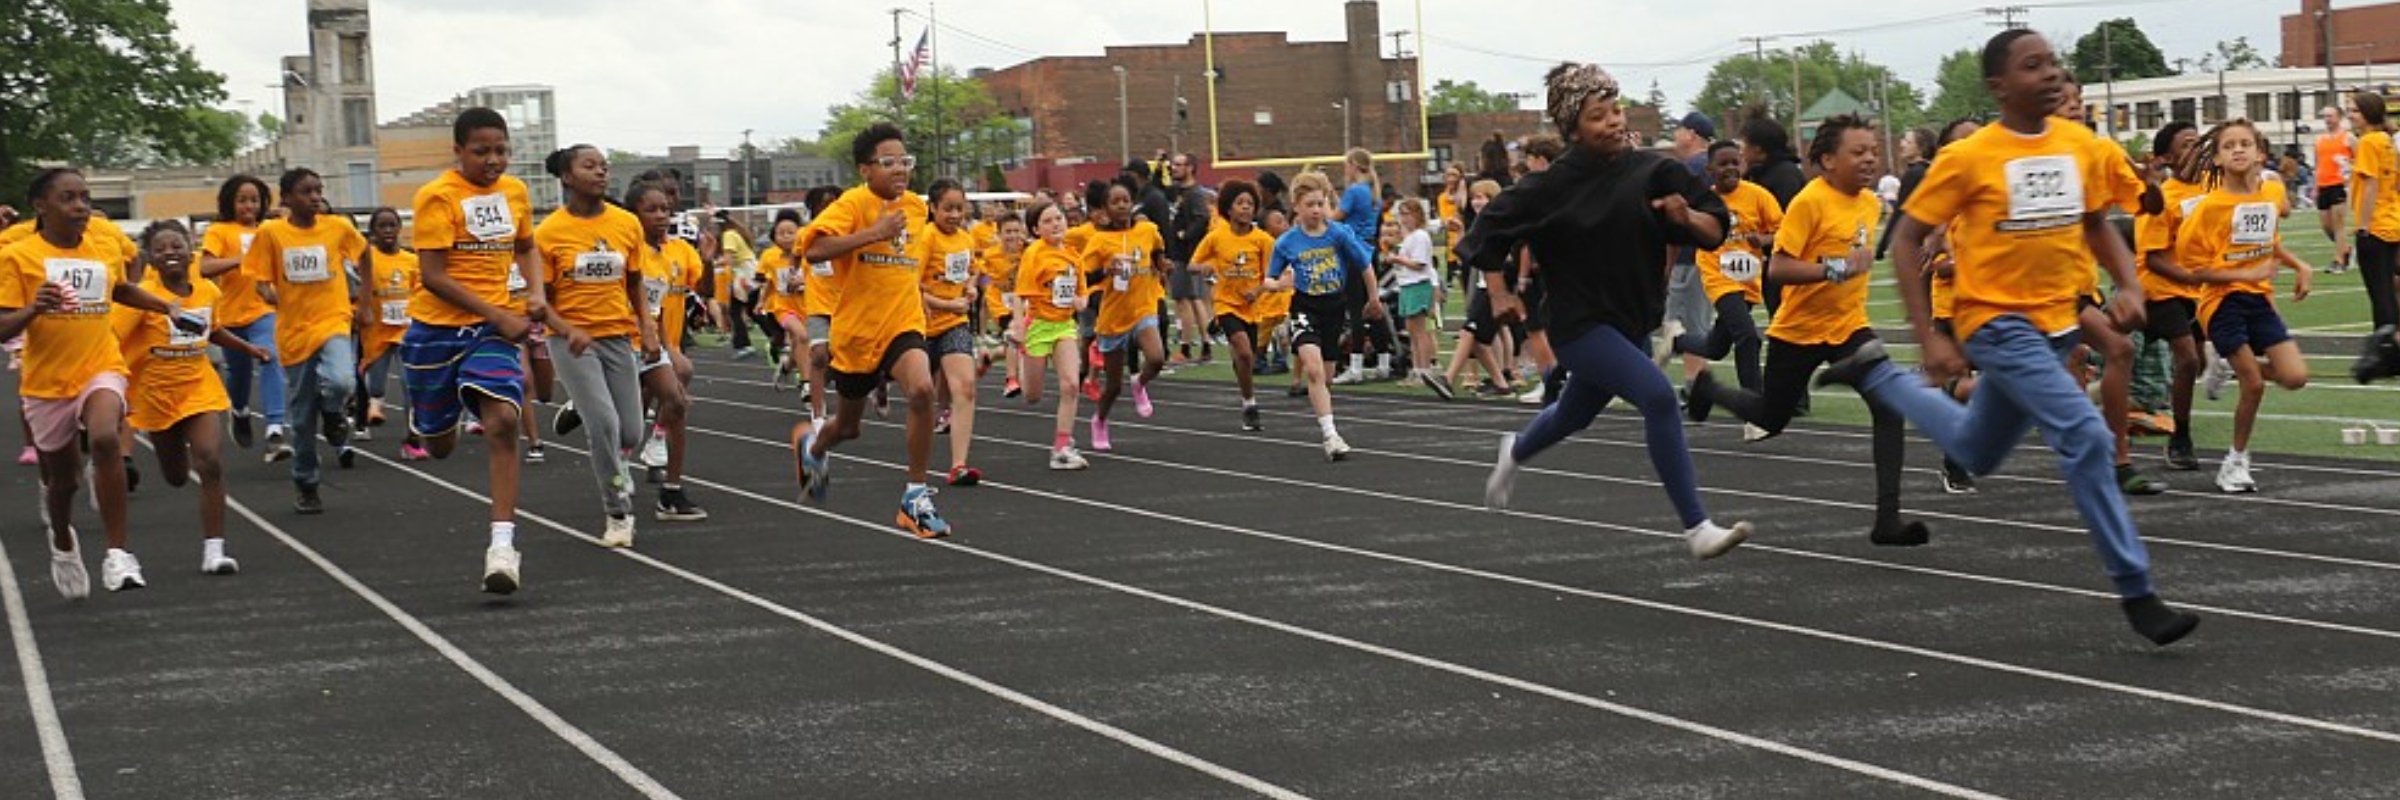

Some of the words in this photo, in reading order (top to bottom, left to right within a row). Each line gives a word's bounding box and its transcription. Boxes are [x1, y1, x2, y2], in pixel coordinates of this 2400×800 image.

[475, 204, 503, 227] 544
[2243, 214, 2267, 232] 392
[1729, 258, 1750, 273] 441
